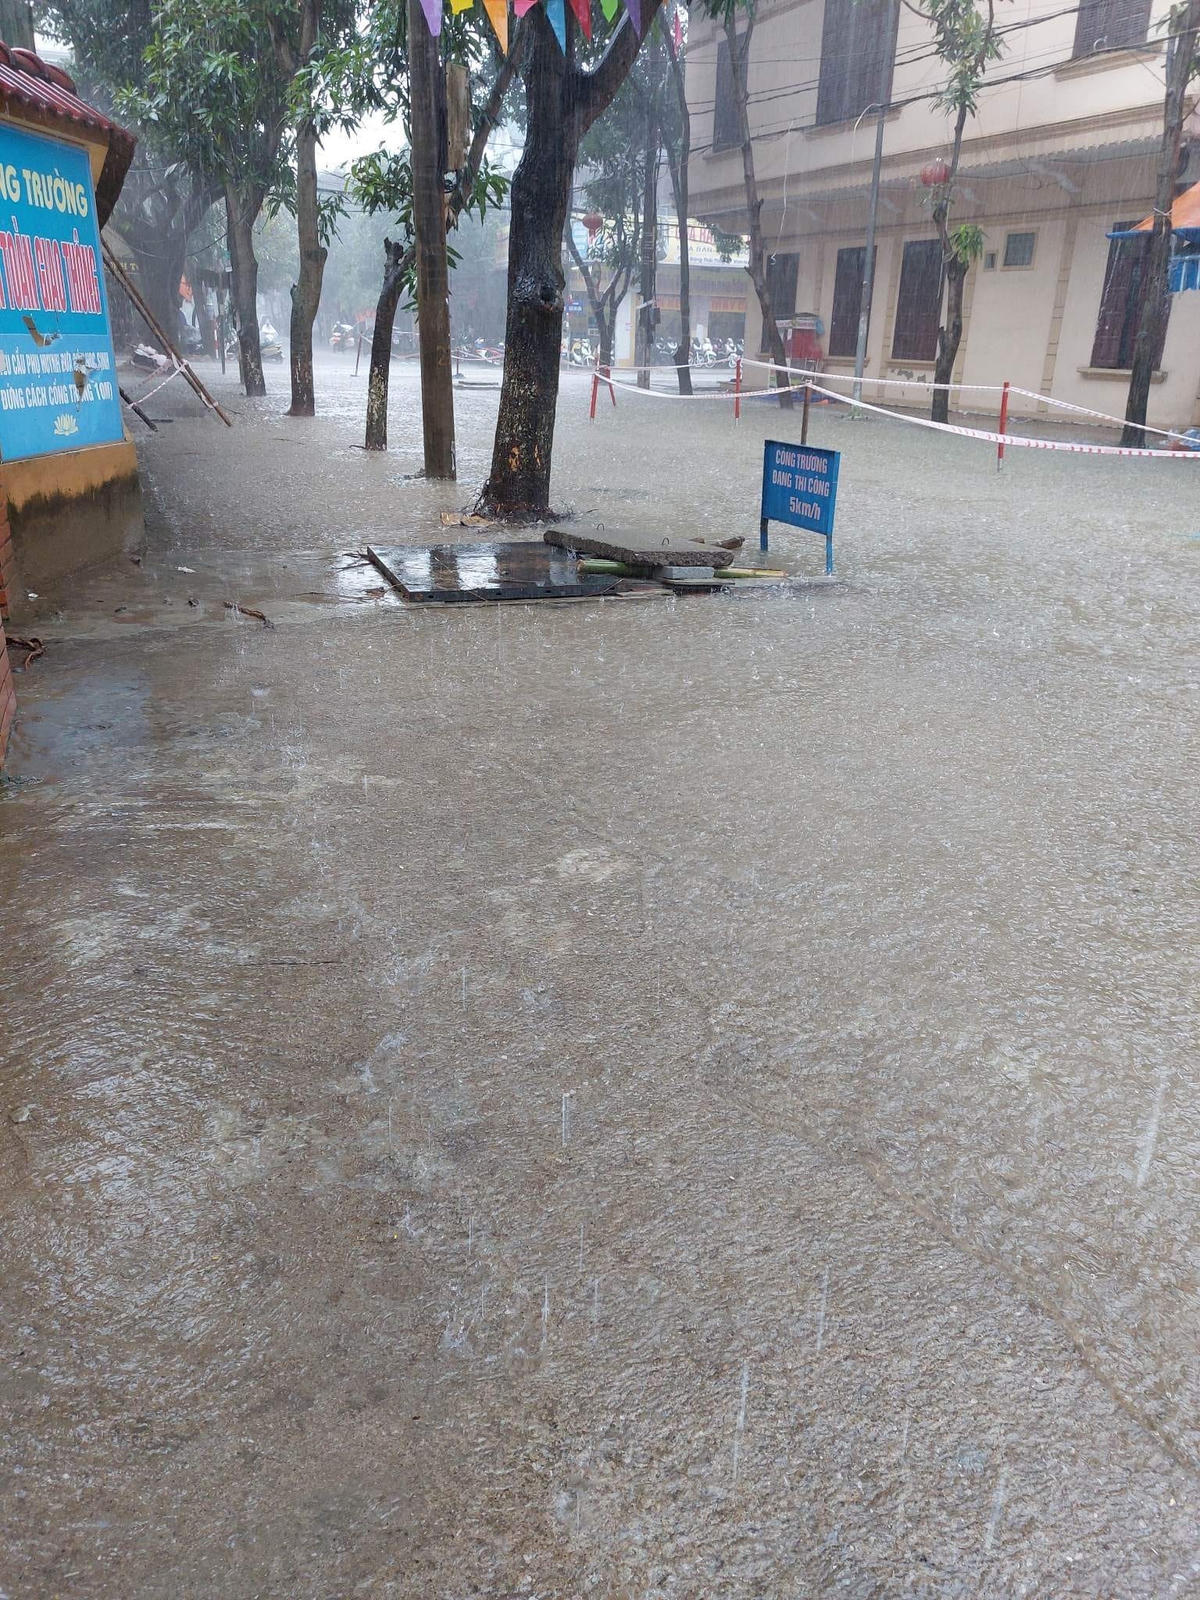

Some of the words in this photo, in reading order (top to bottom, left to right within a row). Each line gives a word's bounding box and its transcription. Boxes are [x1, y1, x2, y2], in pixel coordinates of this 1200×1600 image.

[22, 167, 88, 218] TRƯỜNG
[34, 235, 67, 313] GIAO
[1, 383, 25, 410] ĐỨNG
[26, 383, 48, 407] CÁCH
[775, 447, 796, 467] CÔNG
[794, 475, 807, 491] THI
[807, 475, 830, 497] CÔNG
[789, 496, 821, 520] 5km/h
